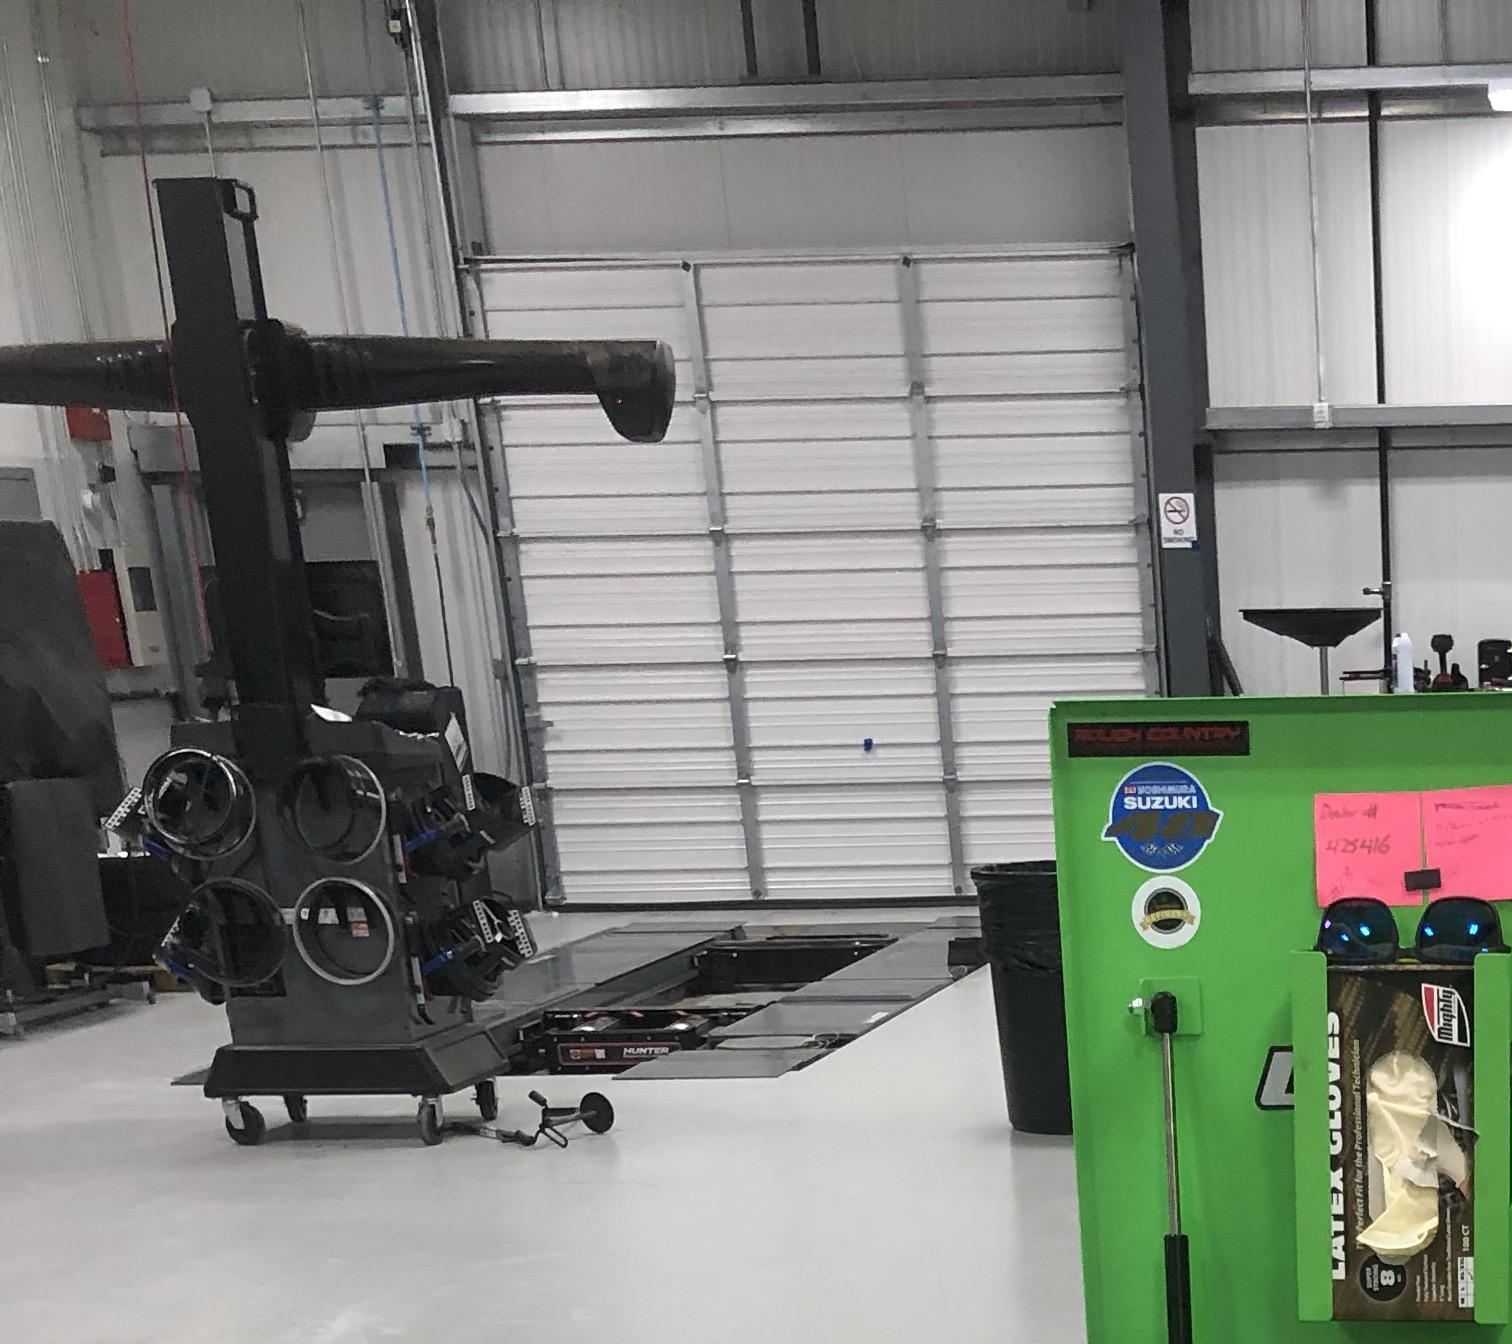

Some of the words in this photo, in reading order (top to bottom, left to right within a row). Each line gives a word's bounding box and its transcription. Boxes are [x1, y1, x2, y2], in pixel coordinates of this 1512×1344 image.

[1123, 796, 1198, 809] SUZUKI
[623, 1047, 669, 1057] HUNTER
[1352, 1039, 1361, 1091] Technician
[1327, 1012, 1343, 1156] GLOVES
[1353, 1091, 1363, 1150] Professional
[1354, 1152, 1364, 1168] the
[1331, 1167, 1346, 1281] LATEX
[1380, 1270, 1395, 1286] 8
